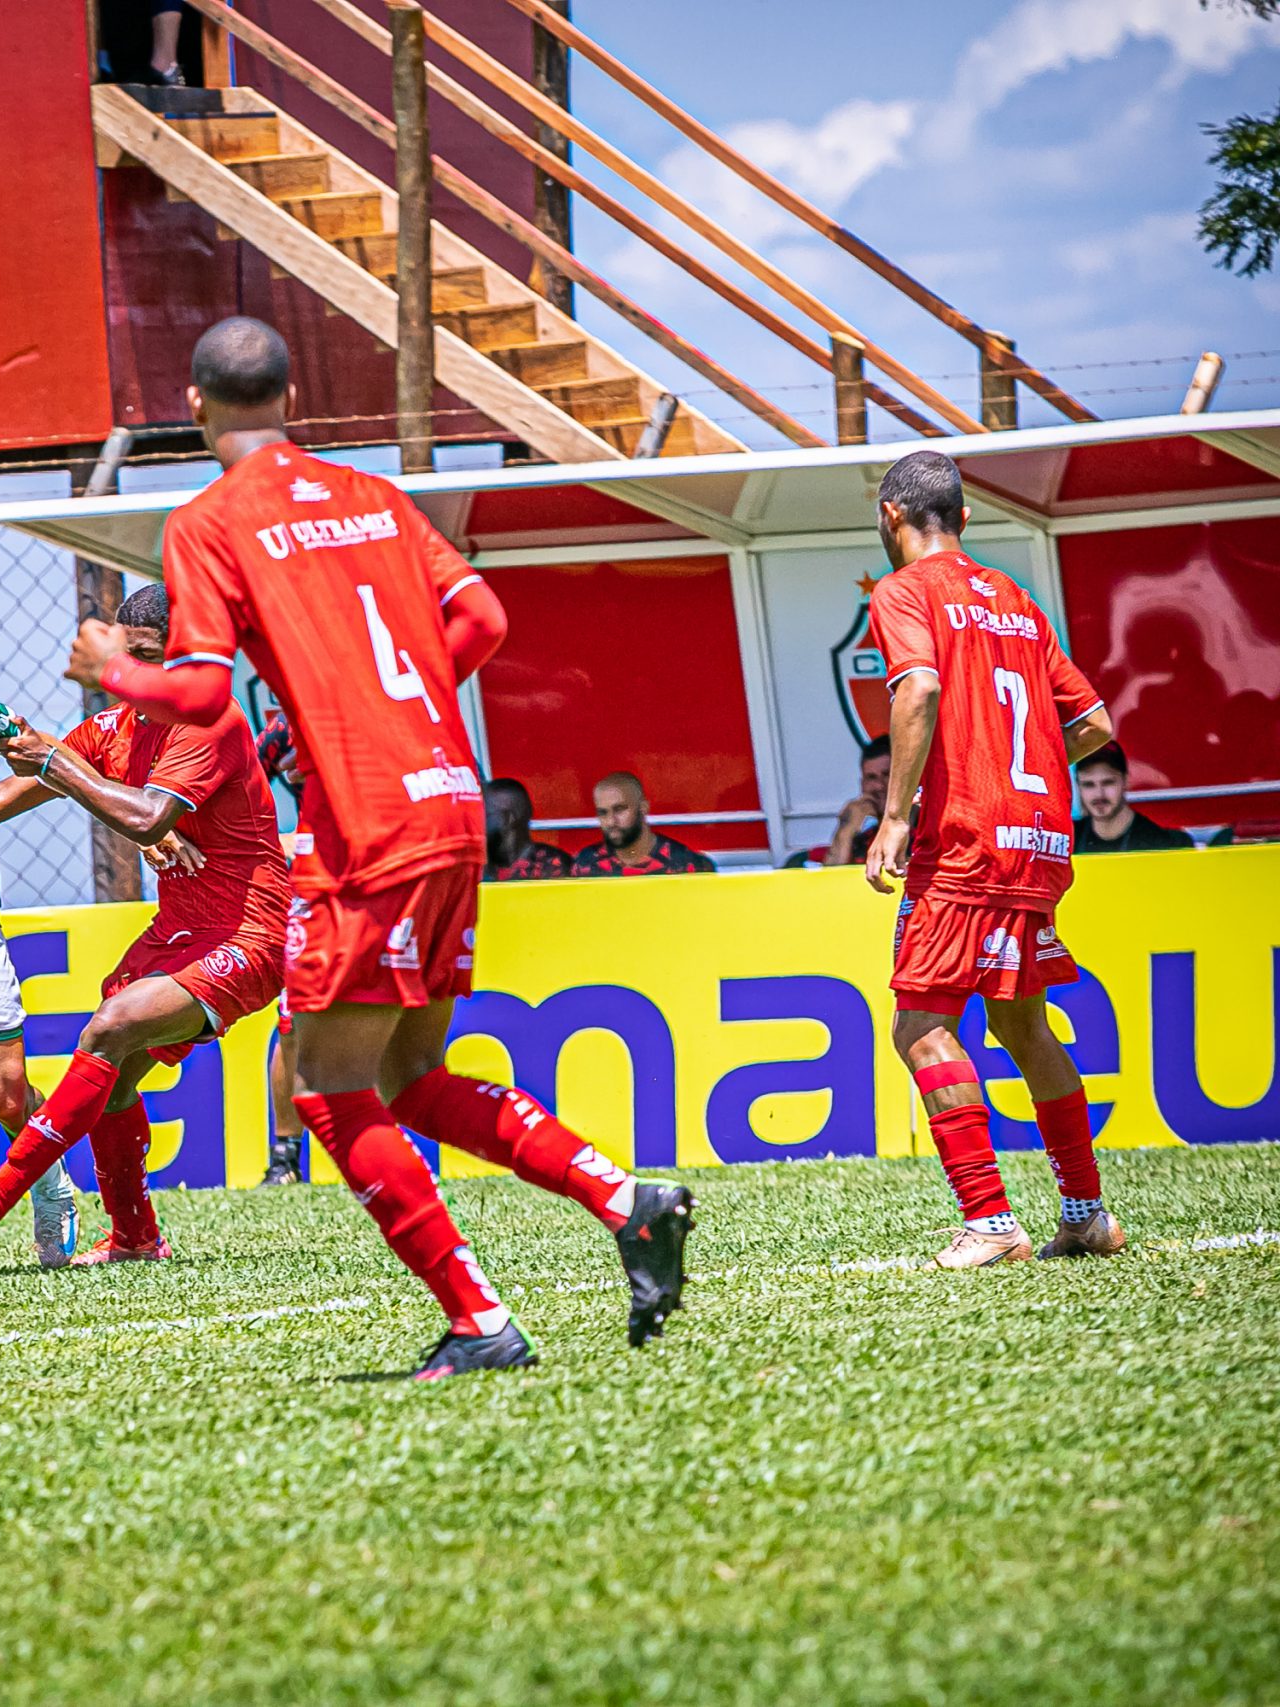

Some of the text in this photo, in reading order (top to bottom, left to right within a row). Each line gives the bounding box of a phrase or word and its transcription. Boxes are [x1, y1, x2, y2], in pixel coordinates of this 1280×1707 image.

[356, 585, 441, 723] 4
[993, 666, 1048, 794] 2
[402, 766, 482, 803] MEST
[995, 825, 1070, 857] MESTRE
